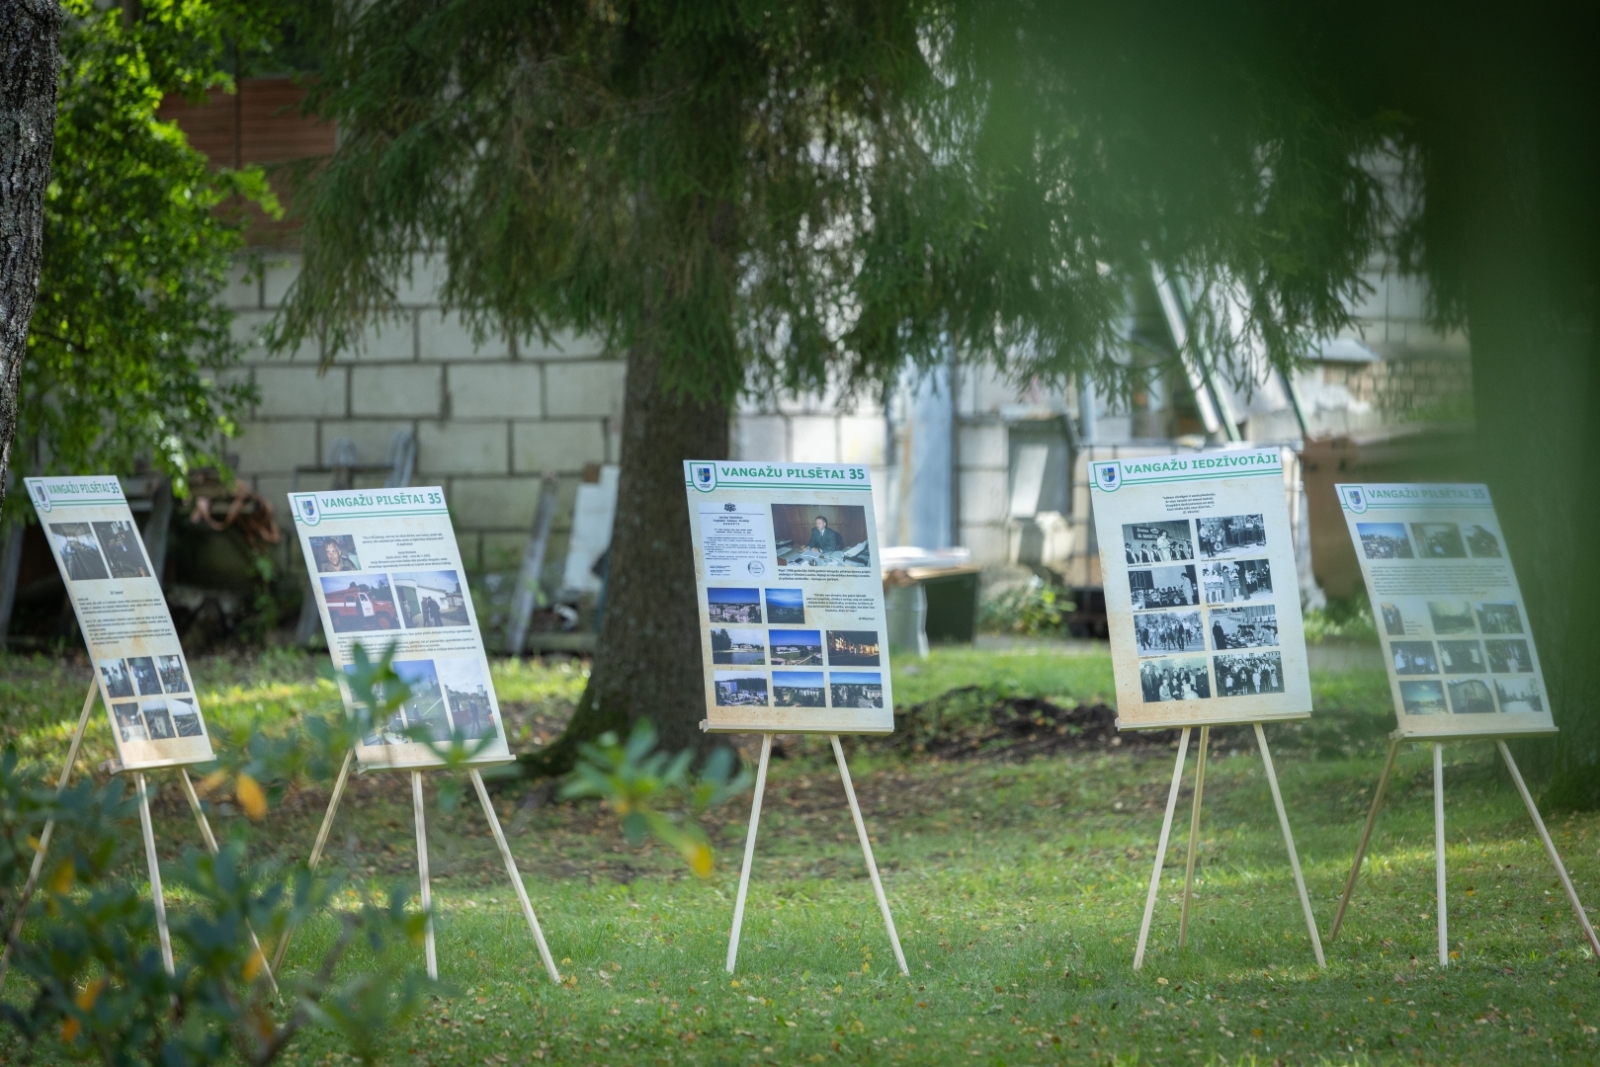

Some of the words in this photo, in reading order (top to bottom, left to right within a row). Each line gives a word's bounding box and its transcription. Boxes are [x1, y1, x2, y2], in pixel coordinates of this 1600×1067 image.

[1124, 458, 1188, 474] VANGAŽU
[1192, 453, 1278, 470] IEDZĪVOTĀJI
[721, 465, 782, 478] VANGAŽU
[787, 467, 845, 479] PILSĒTAI
[849, 468, 865, 480] 35
[47, 481, 80, 494] VANGAŽU
[80, 481, 111, 493] PILSĒTAI
[109, 482, 120, 494] 35
[1368, 487, 1419, 499] VANGAŽU
[1421, 487, 1470, 499] PILSĒTAI
[1472, 488, 1486, 499] 35
[321, 494, 374, 508] VANGAŽU
[377, 492, 425, 505] PILSĒTAI
[427, 492, 442, 504] 35
